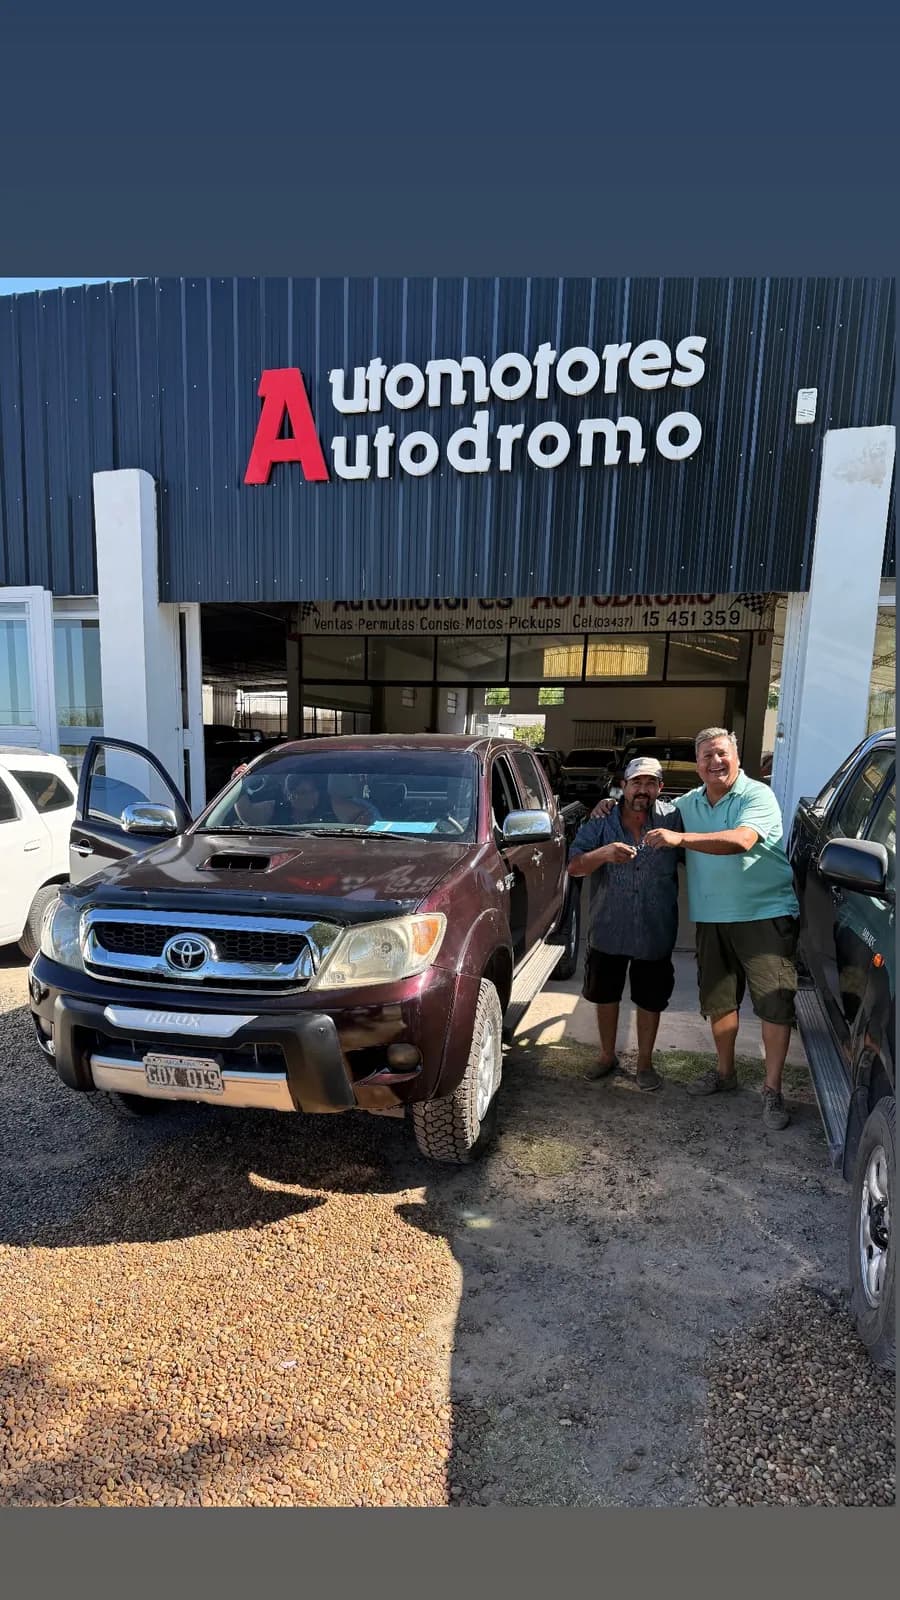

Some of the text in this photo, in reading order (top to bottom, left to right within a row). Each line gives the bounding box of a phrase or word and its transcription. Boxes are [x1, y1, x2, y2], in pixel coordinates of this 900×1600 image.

[313, 617, 353, 631] Ventas
[358, 617, 415, 632] Permutas
[465, 615, 503, 630] Motos
[509, 614, 561, 631] Pickups
[642, 610, 660, 627] 15
[667, 610, 696, 627] 451
[702, 609, 741, 626] 359
